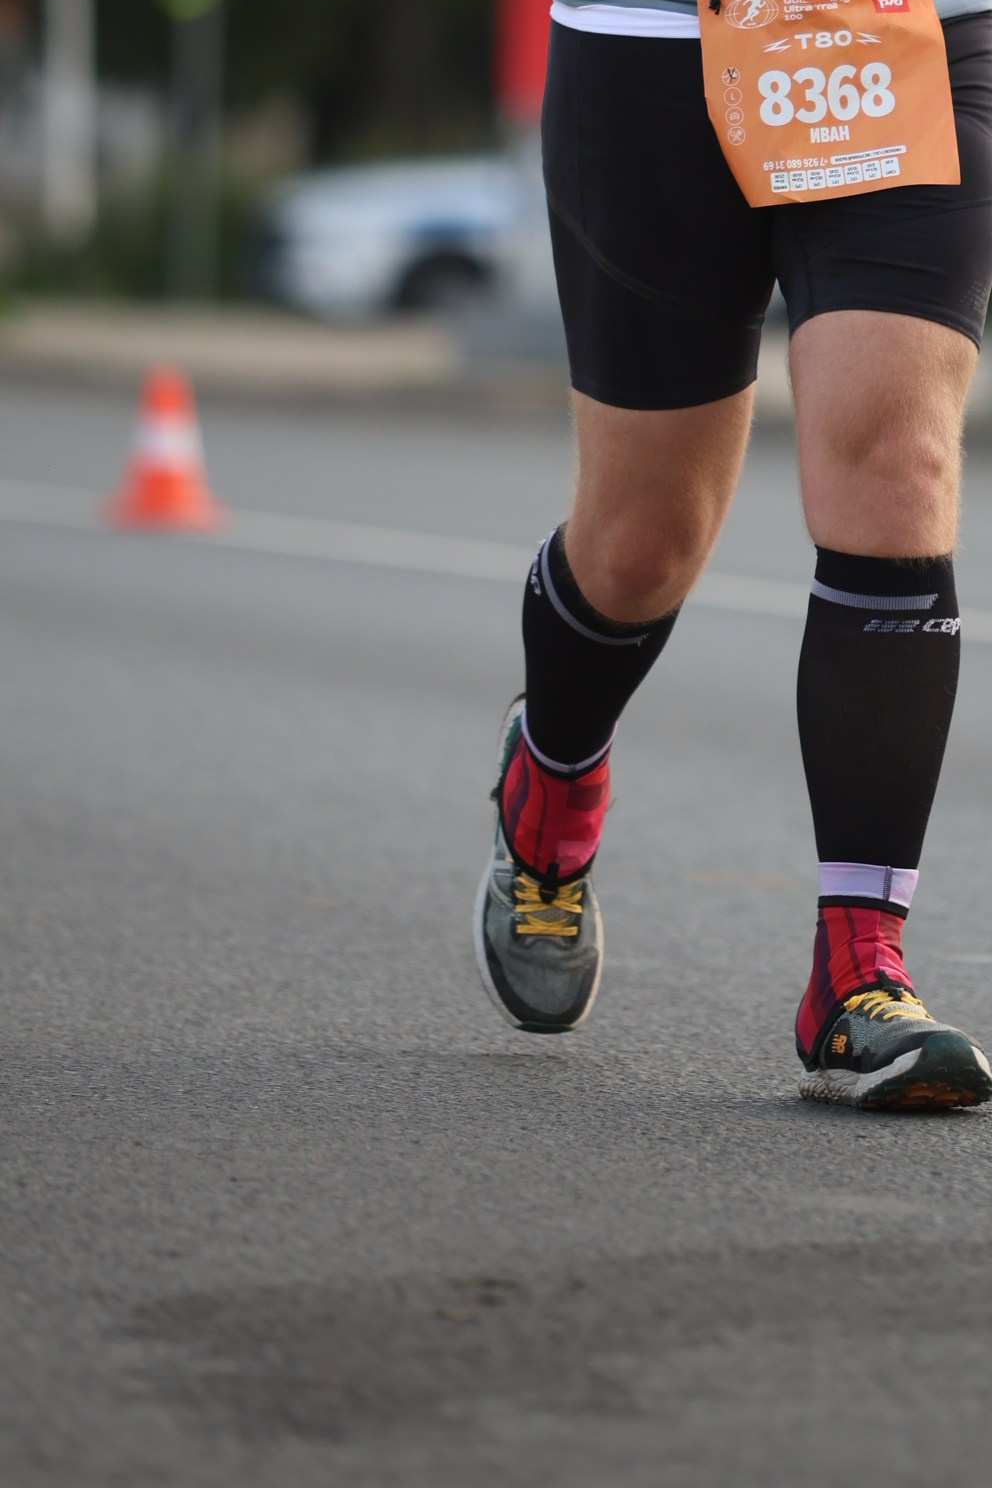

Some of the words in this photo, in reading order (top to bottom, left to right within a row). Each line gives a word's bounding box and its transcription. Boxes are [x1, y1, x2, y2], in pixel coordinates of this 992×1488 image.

[783, 4, 813, 13] Ultra
[794, 30, 853, 50] T80
[757, 61, 896, 127] 8368
[810, 124, 850, 144] ИВАН
[763, 161, 774, 171] 69
[776, 160, 785, 170] 31
[787, 159, 802, 169] 680
[803, 158, 819, 168] 926
[922, 617, 960, 636] cep
